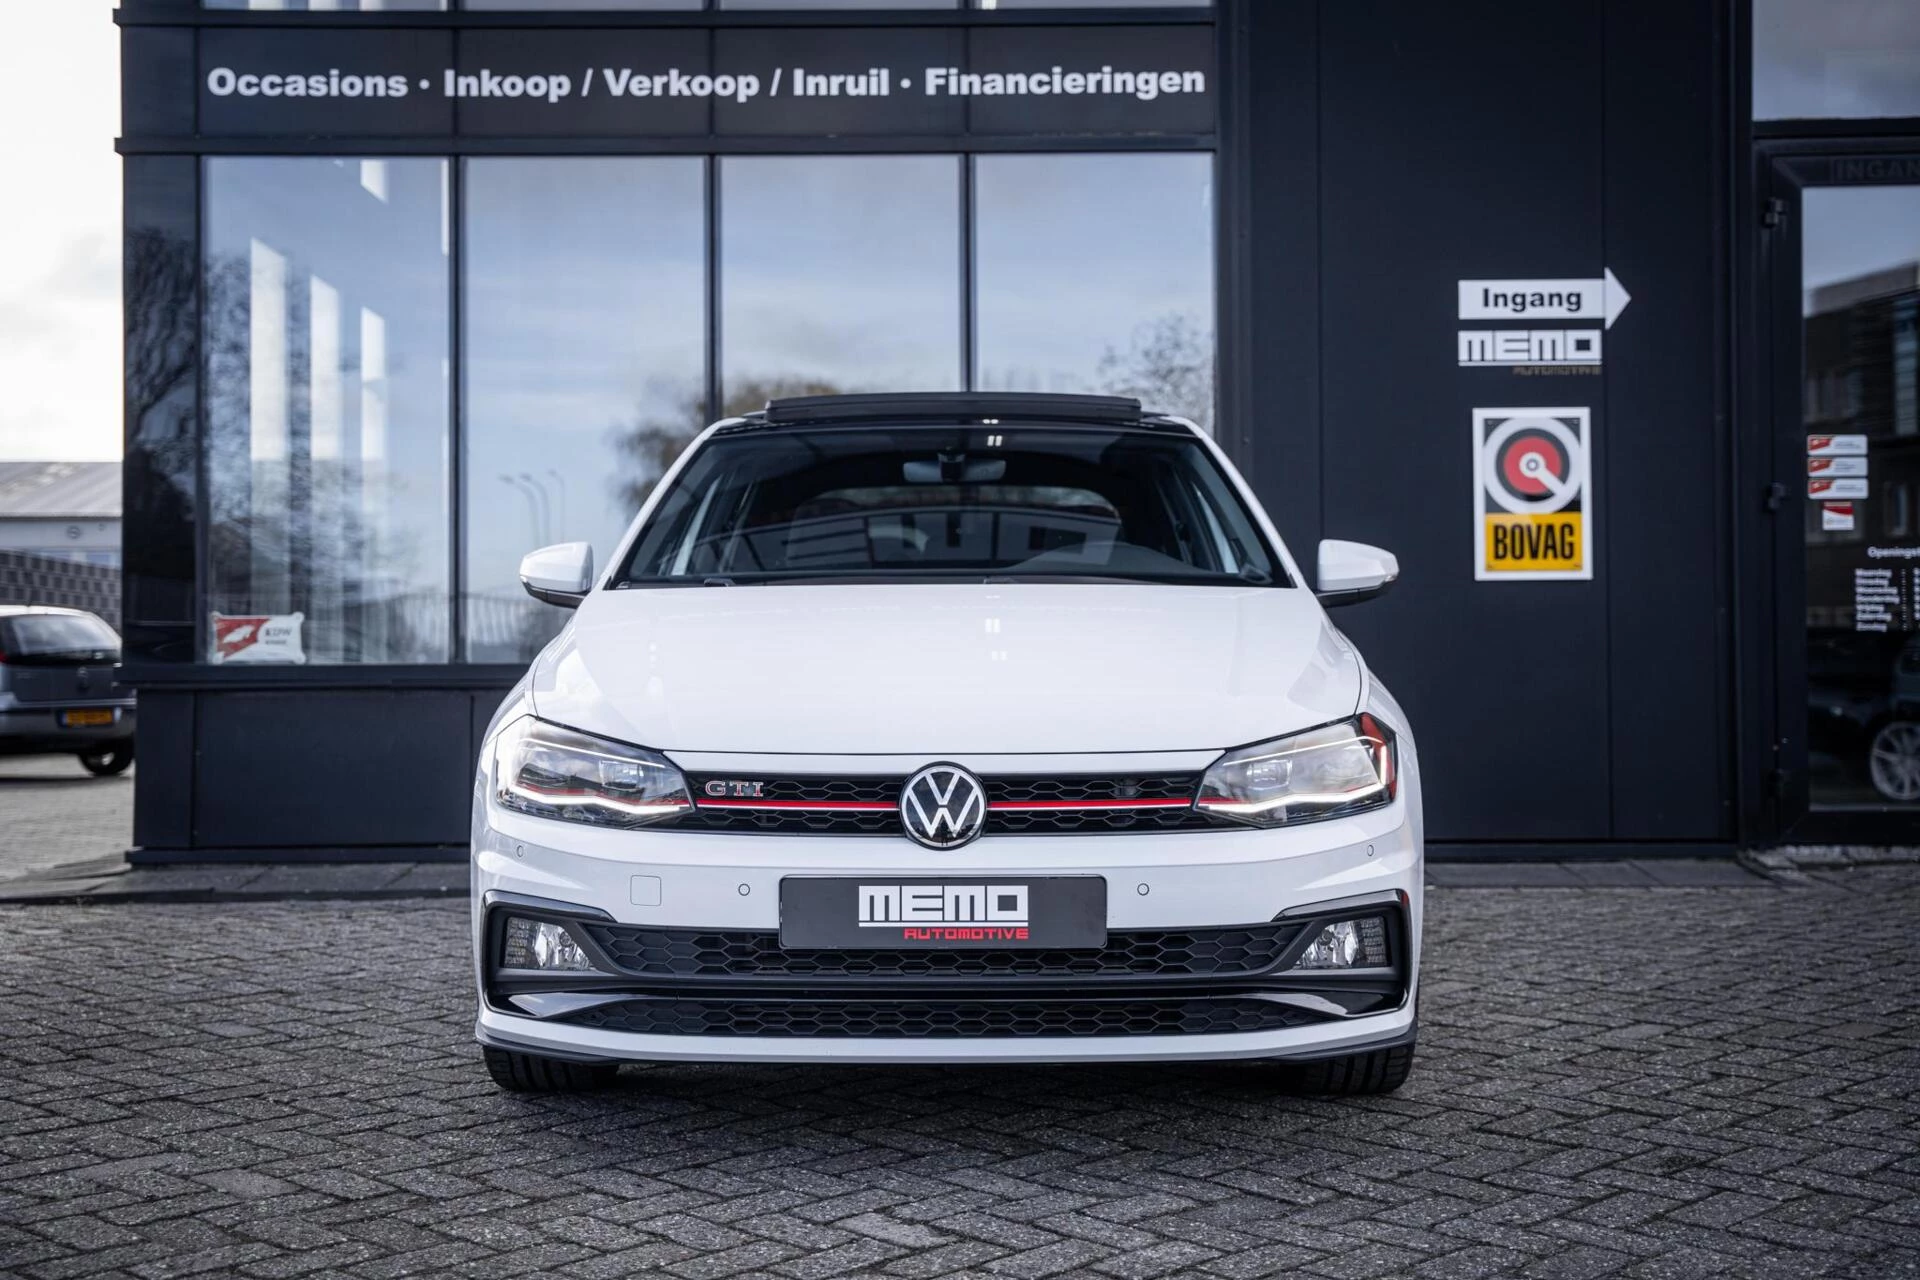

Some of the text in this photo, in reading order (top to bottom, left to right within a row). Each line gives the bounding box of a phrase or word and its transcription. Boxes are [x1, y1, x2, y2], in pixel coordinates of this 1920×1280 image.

[207, 67, 409, 98] Occasions
[444, 68, 572, 104] Inkoop
[602, 68, 760, 104] Verkoop
[793, 67, 890, 97] Inruil
[925, 65, 1206, 101] Financieringen
[1482, 287, 1583, 313] Ingang
[1458, 330, 1602, 364] MEMO
[1492, 522, 1576, 562] BOVAG
[704, 780, 765, 798] GTI
[858, 885, 1029, 922] MEMO
[903, 927, 1029, 940] AUTOMOTIVE
